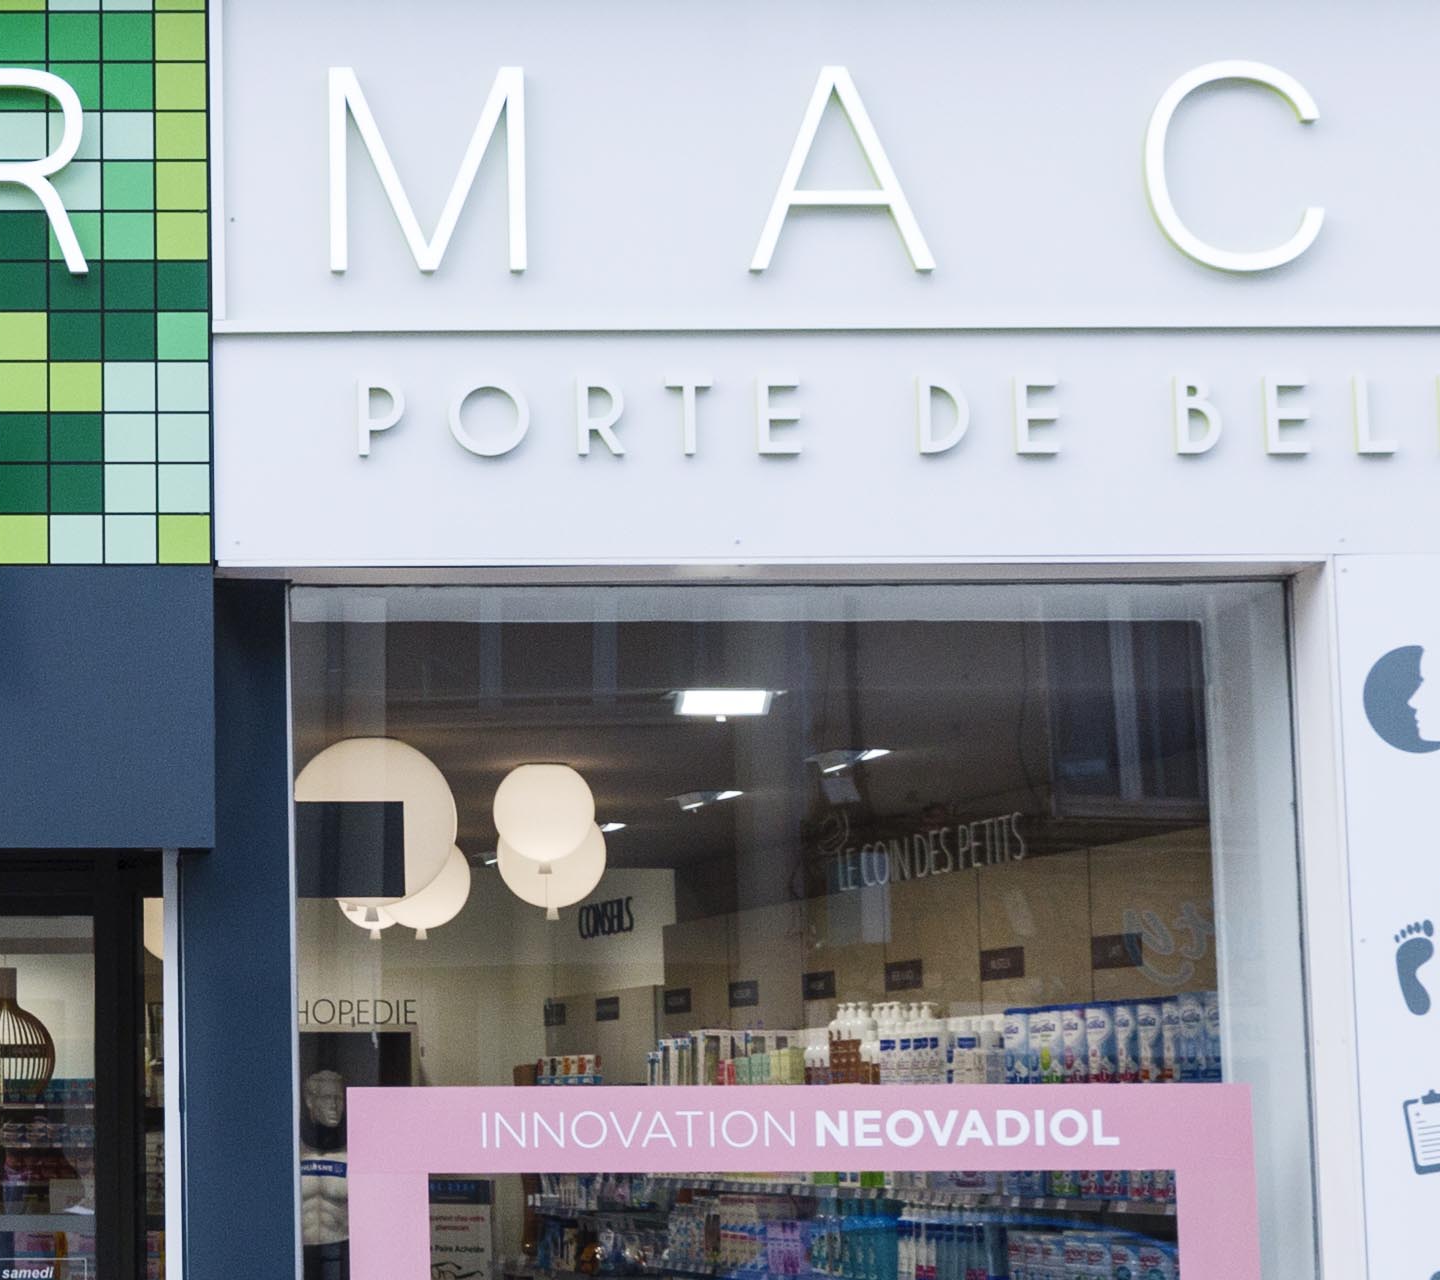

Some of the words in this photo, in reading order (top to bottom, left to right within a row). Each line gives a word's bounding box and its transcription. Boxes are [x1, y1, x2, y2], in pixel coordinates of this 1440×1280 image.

[356, 372, 804, 458] PORTE
[916, 371, 1064, 458] DE
[481, 1110, 798, 1149] INNOVATION
[815, 1107, 1121, 1148] NEOVADIOL
[2, 1266, 54, 1280] samedi
